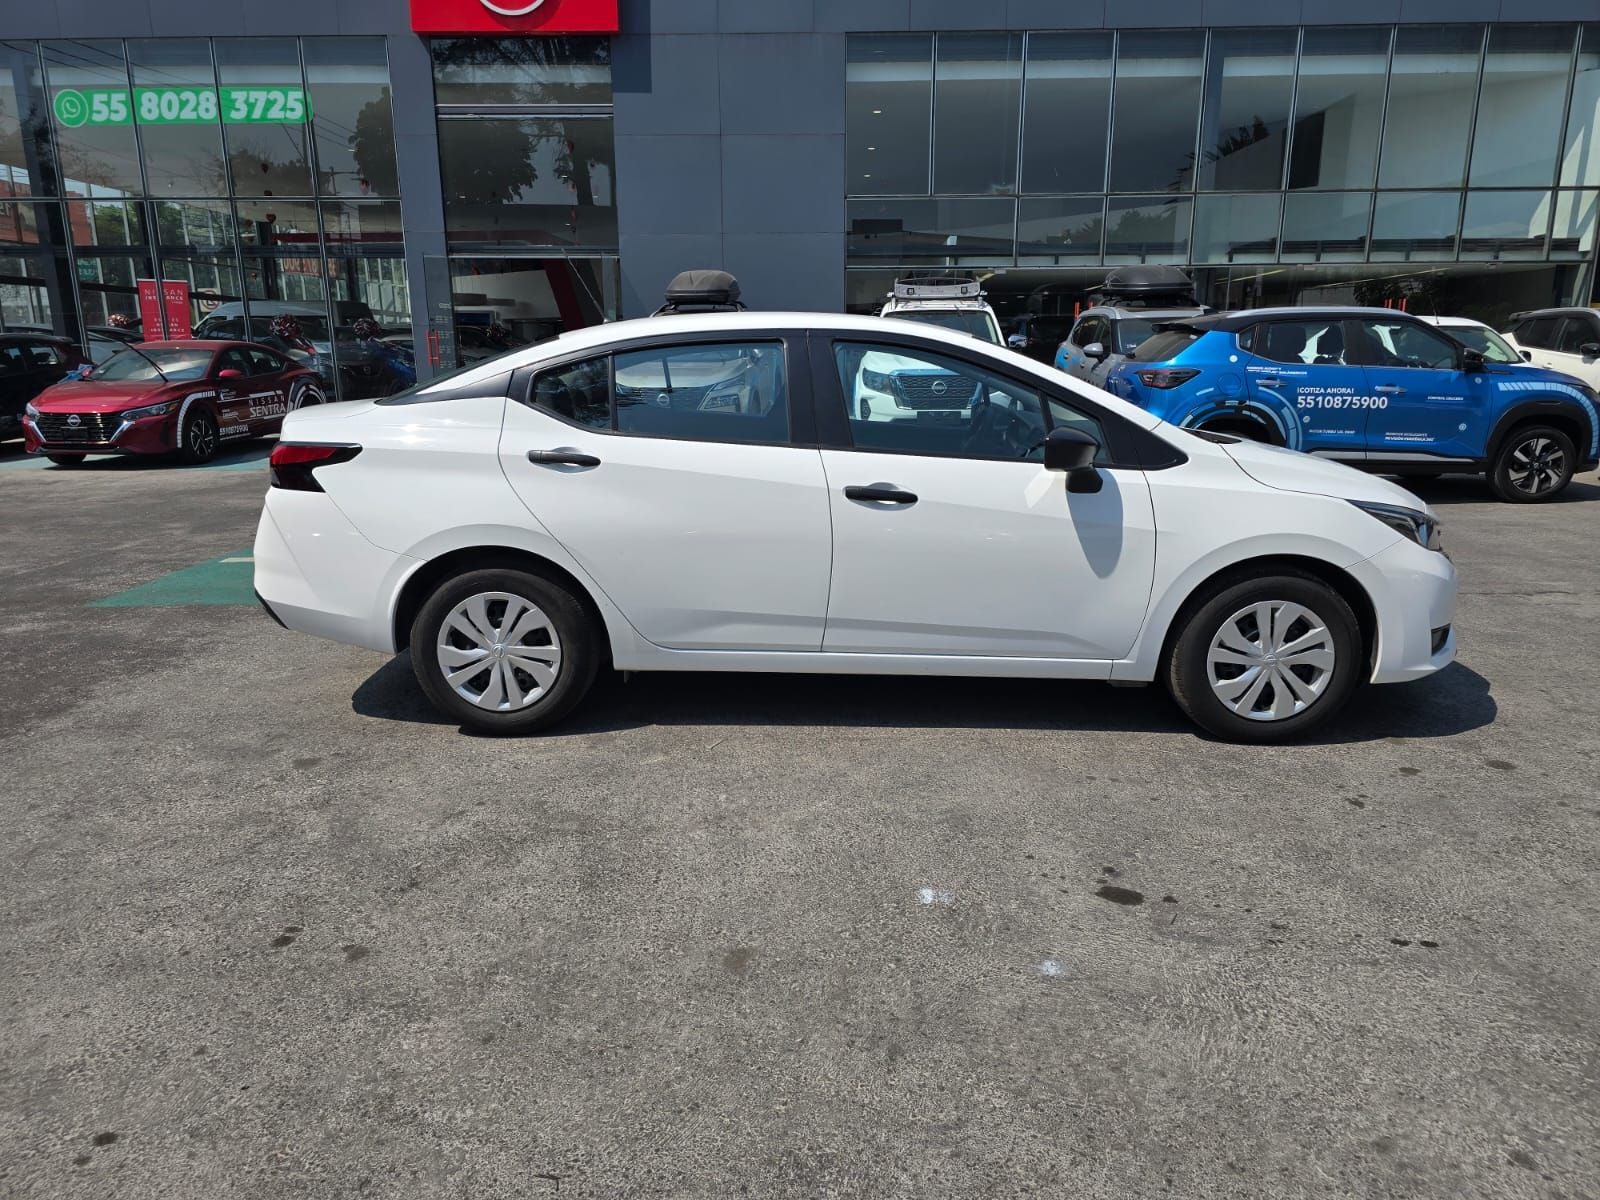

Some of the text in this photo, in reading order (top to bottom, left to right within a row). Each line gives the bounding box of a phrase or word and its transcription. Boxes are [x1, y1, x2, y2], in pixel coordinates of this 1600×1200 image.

[91, 90, 305, 122] 55 8028 3725
[144, 288, 184, 296] NISAN
[248, 394, 285, 407] NISSAN
[1296, 395, 1388, 409] 5510875900
[249, 403, 287, 418] SENTRA
